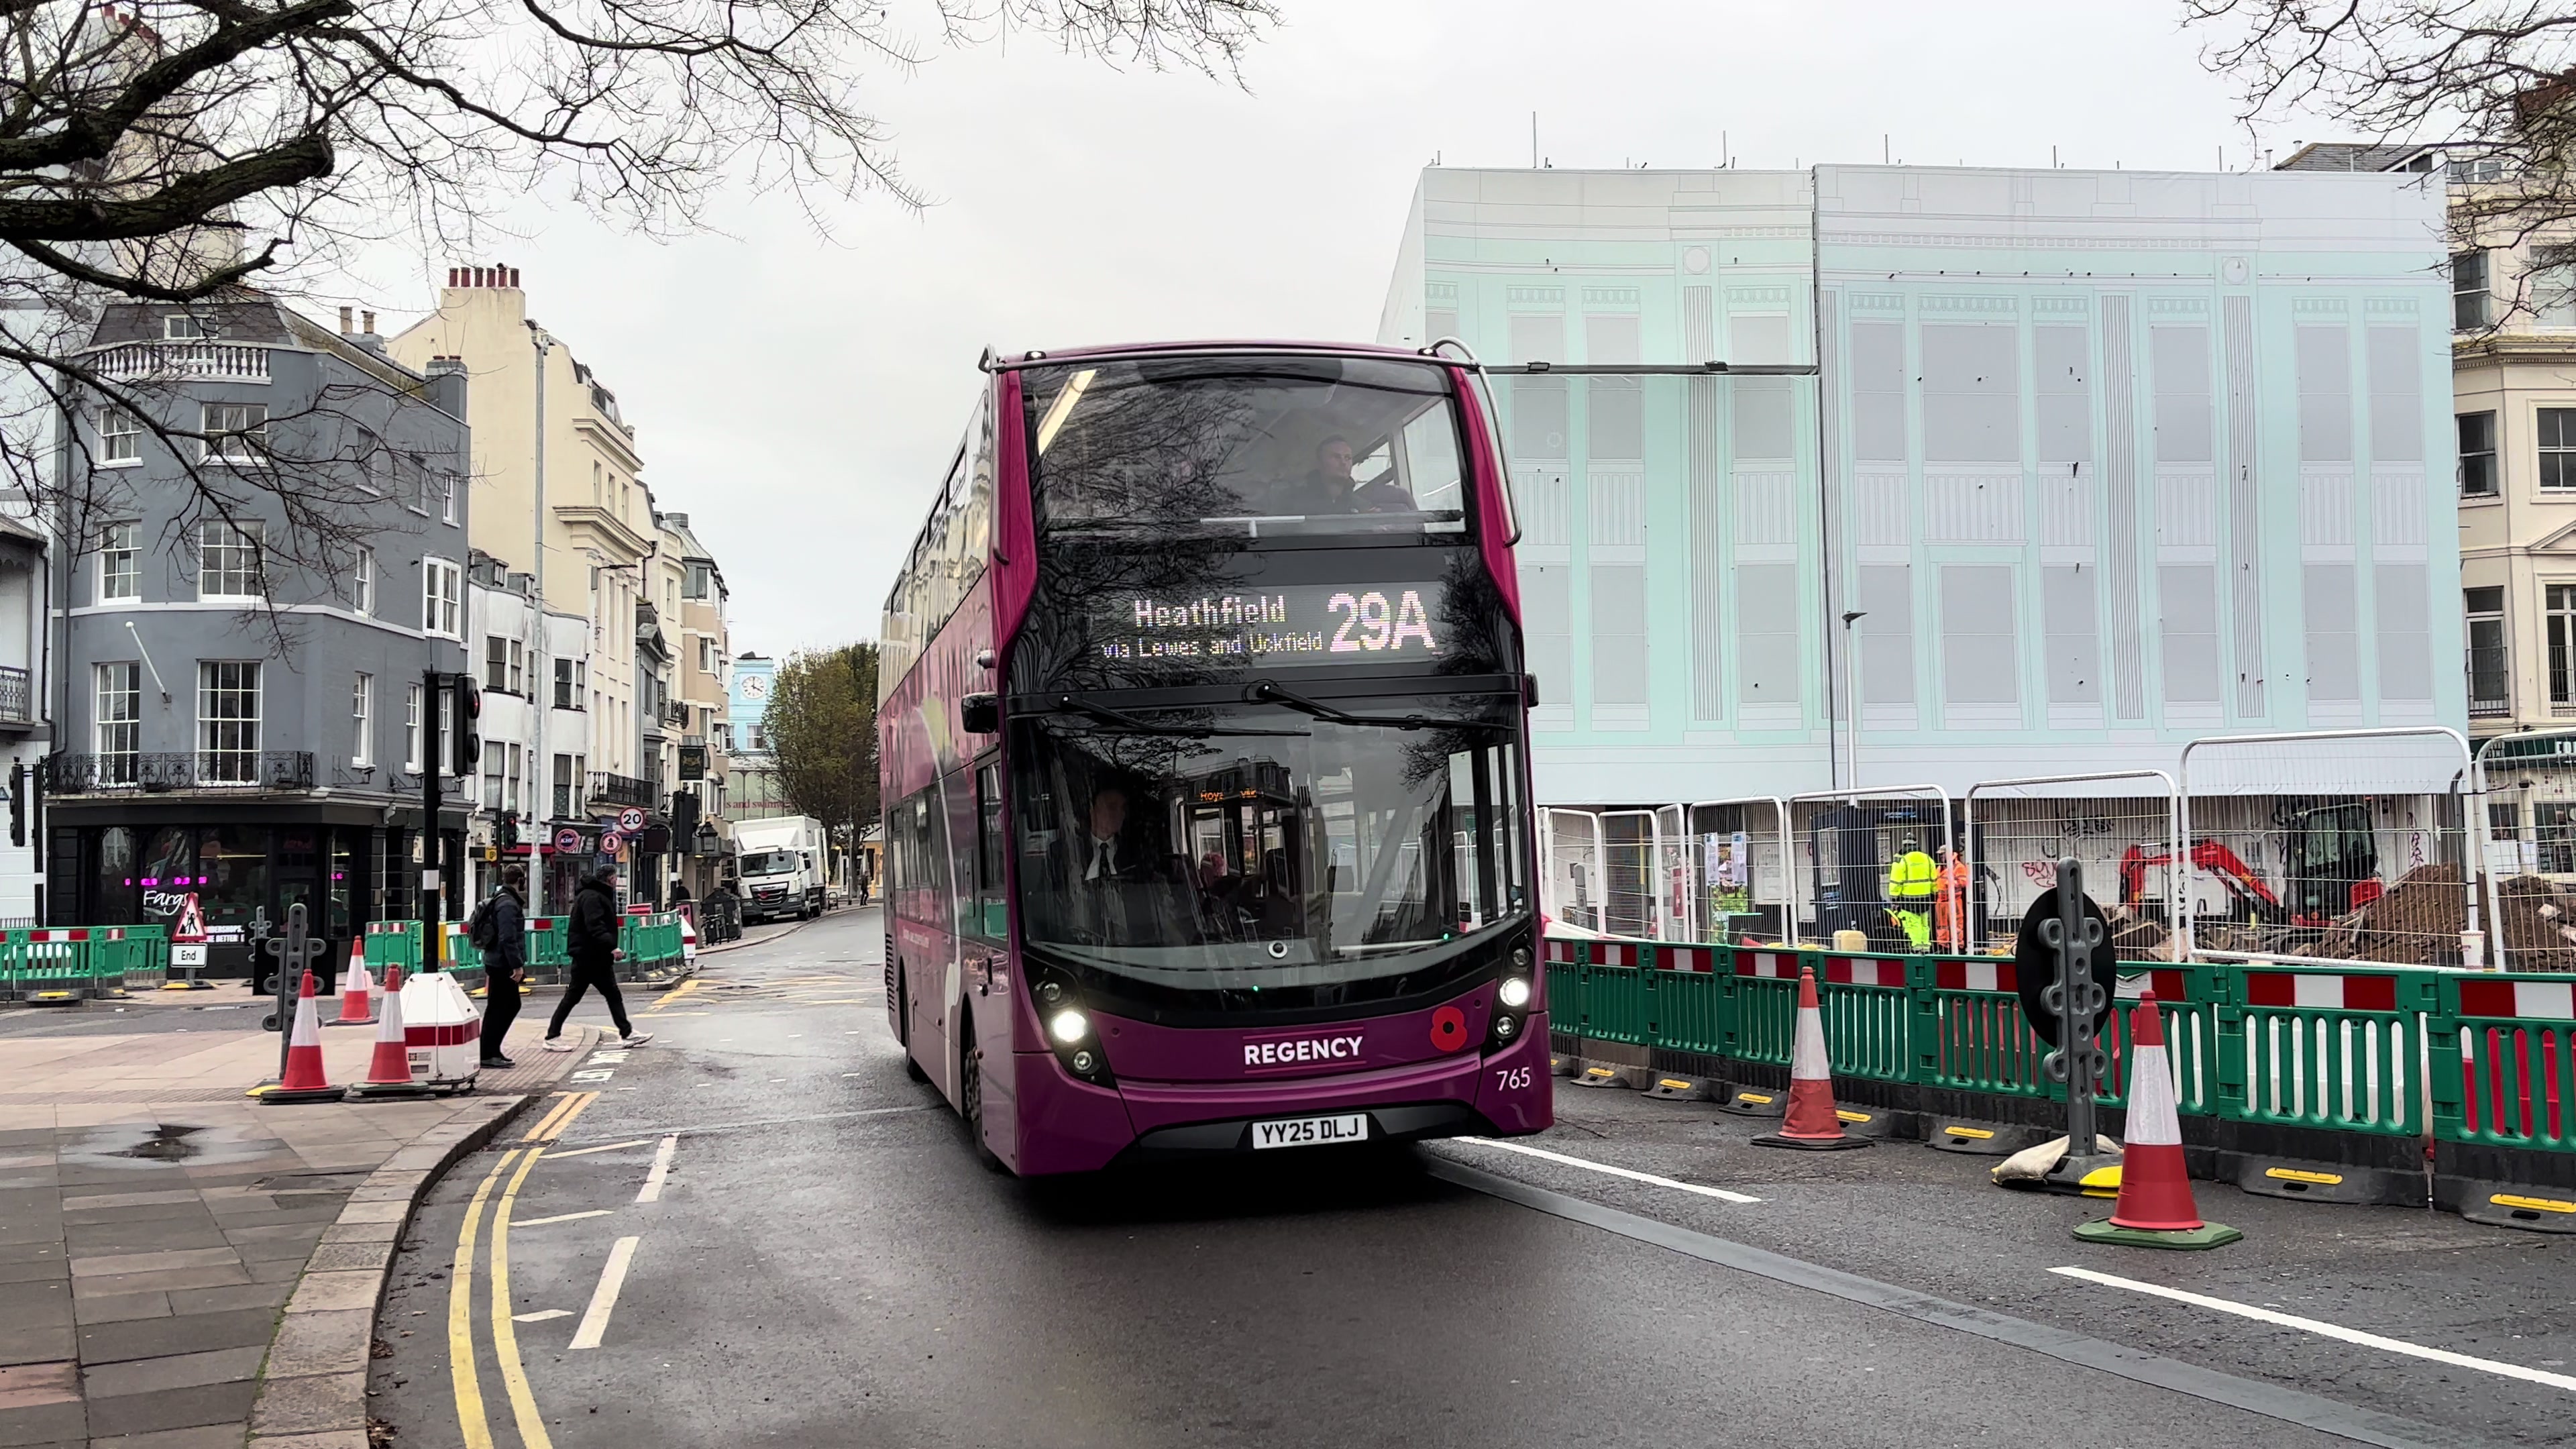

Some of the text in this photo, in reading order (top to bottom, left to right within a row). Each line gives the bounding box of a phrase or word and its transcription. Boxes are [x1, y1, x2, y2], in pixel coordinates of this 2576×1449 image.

[1134, 595, 1285, 627] Heathfield
[1327, 590, 1436, 651] 29A
[1101, 631, 1323, 658] via Lewes and Uckfield
[733, 798, 750, 809] and
[623, 814, 641, 824] 20
[181, 950, 197, 961] End
[1244, 1036, 1363, 1065] REGENCY
[1496, 1067, 1531, 1091] 765
[1261, 1118, 1358, 1144] YY25 DLJ
